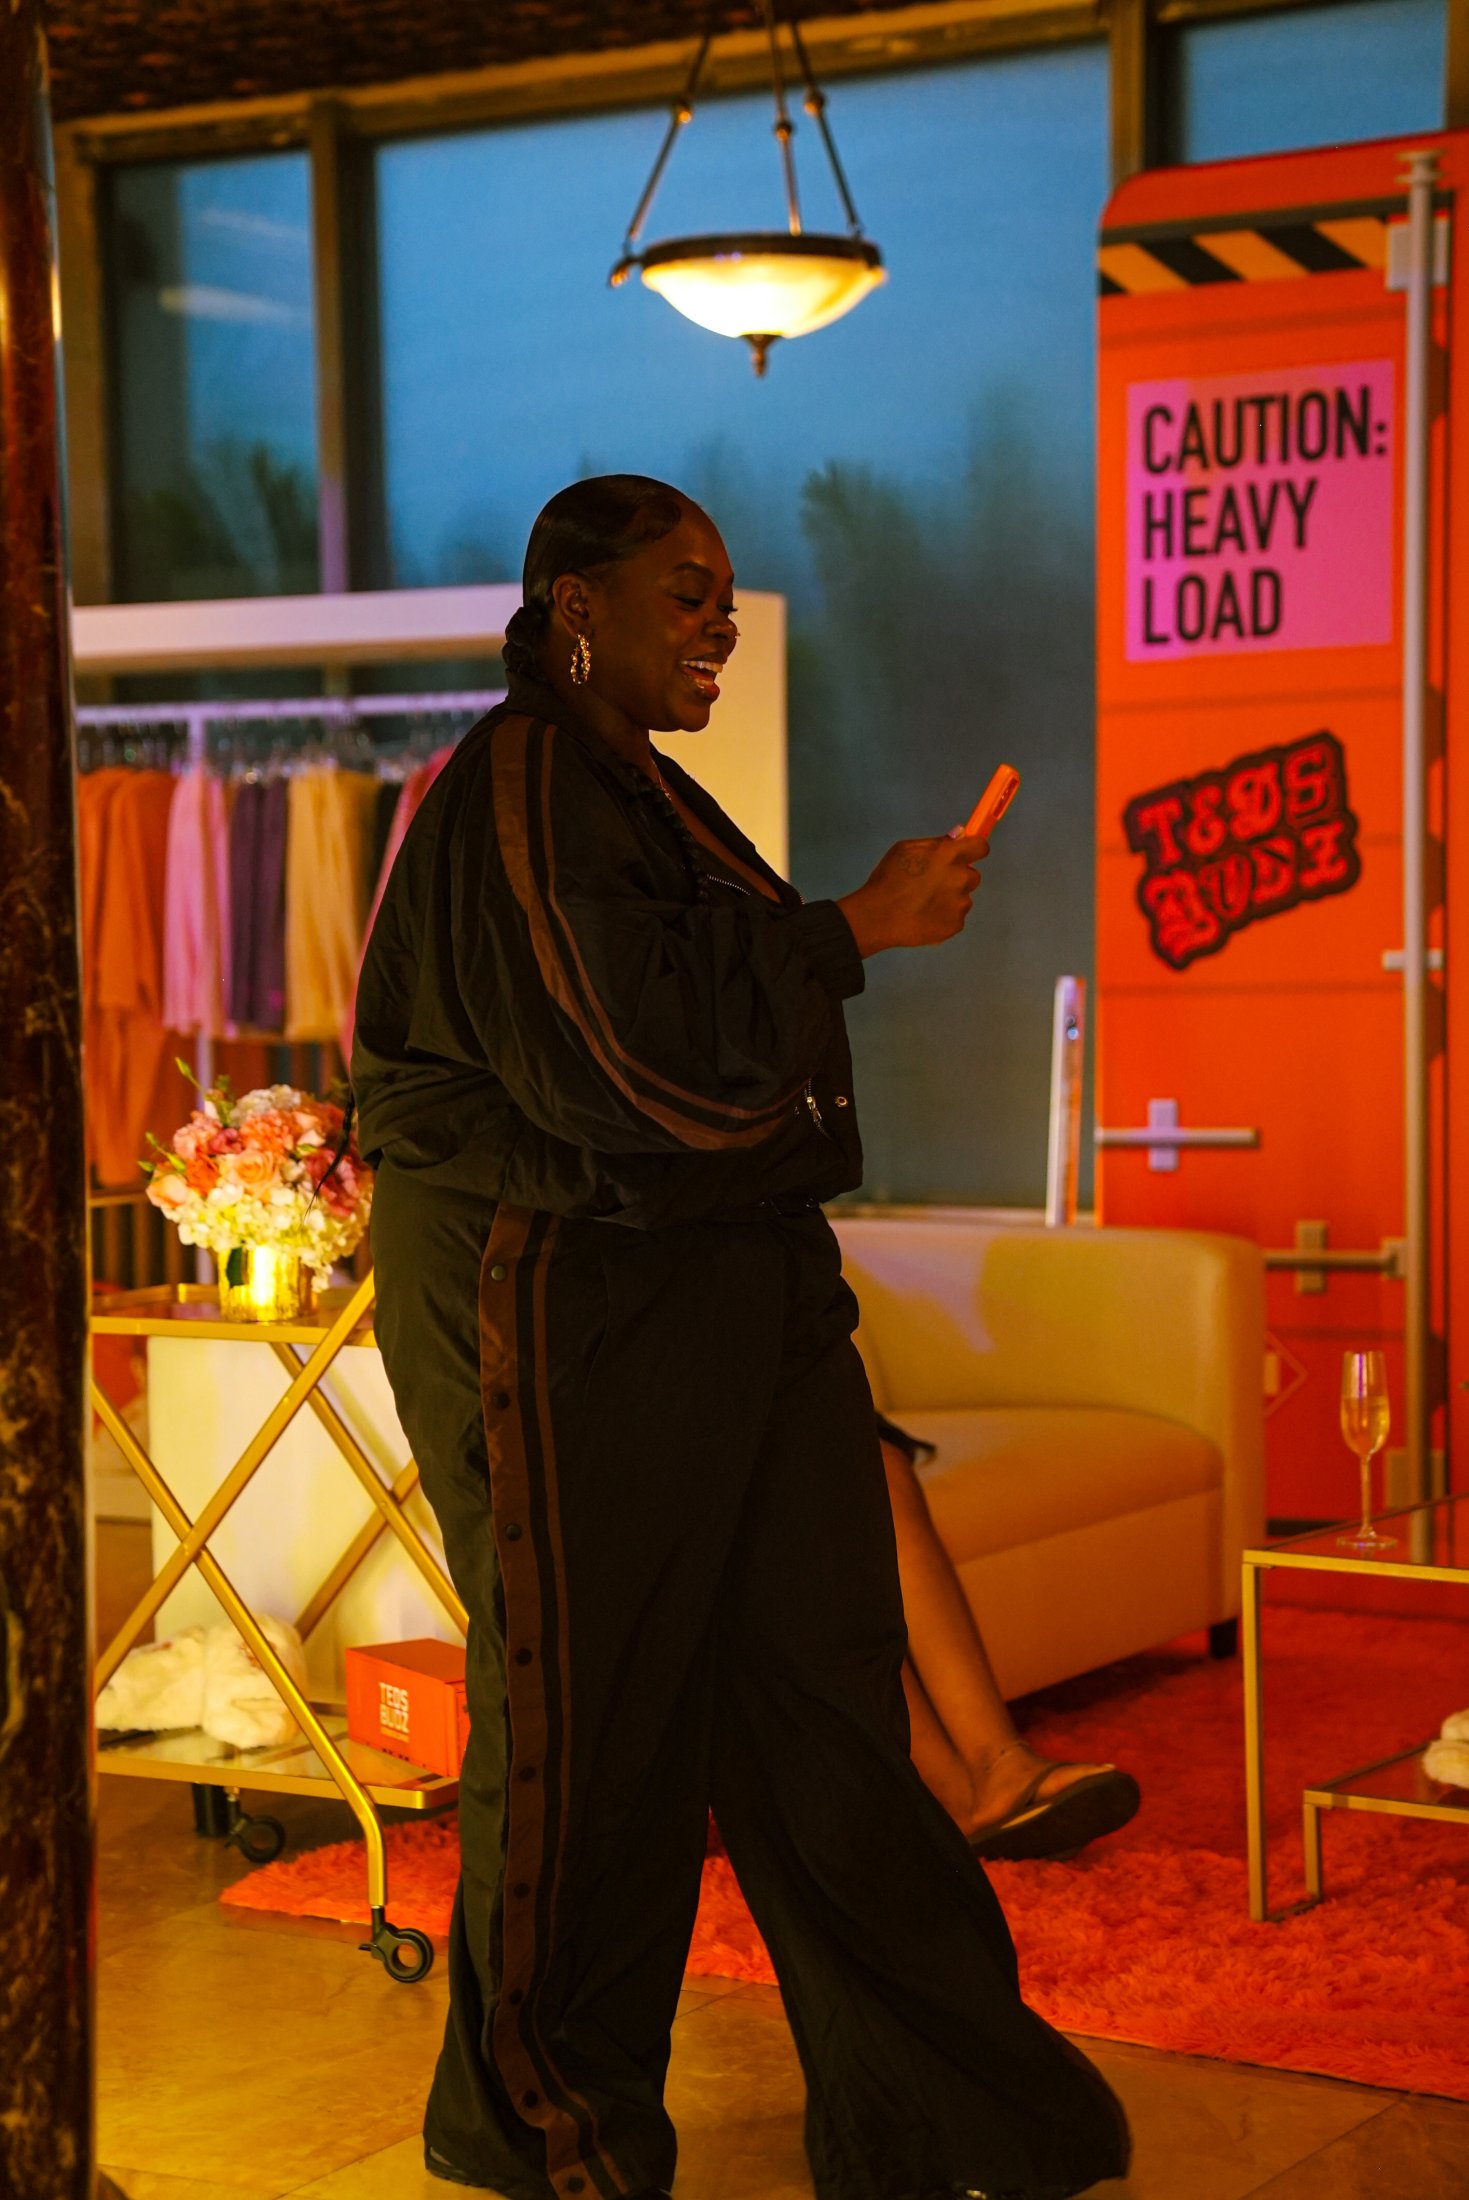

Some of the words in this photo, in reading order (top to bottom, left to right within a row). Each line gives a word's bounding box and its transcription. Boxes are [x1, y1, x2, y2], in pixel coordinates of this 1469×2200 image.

[1143, 384, 1388, 475] CAUTION:
[1143, 476, 1319, 561] HEAVY
[1143, 566, 1282, 645] LOAD
[379, 1682, 409, 1712] TEDS
